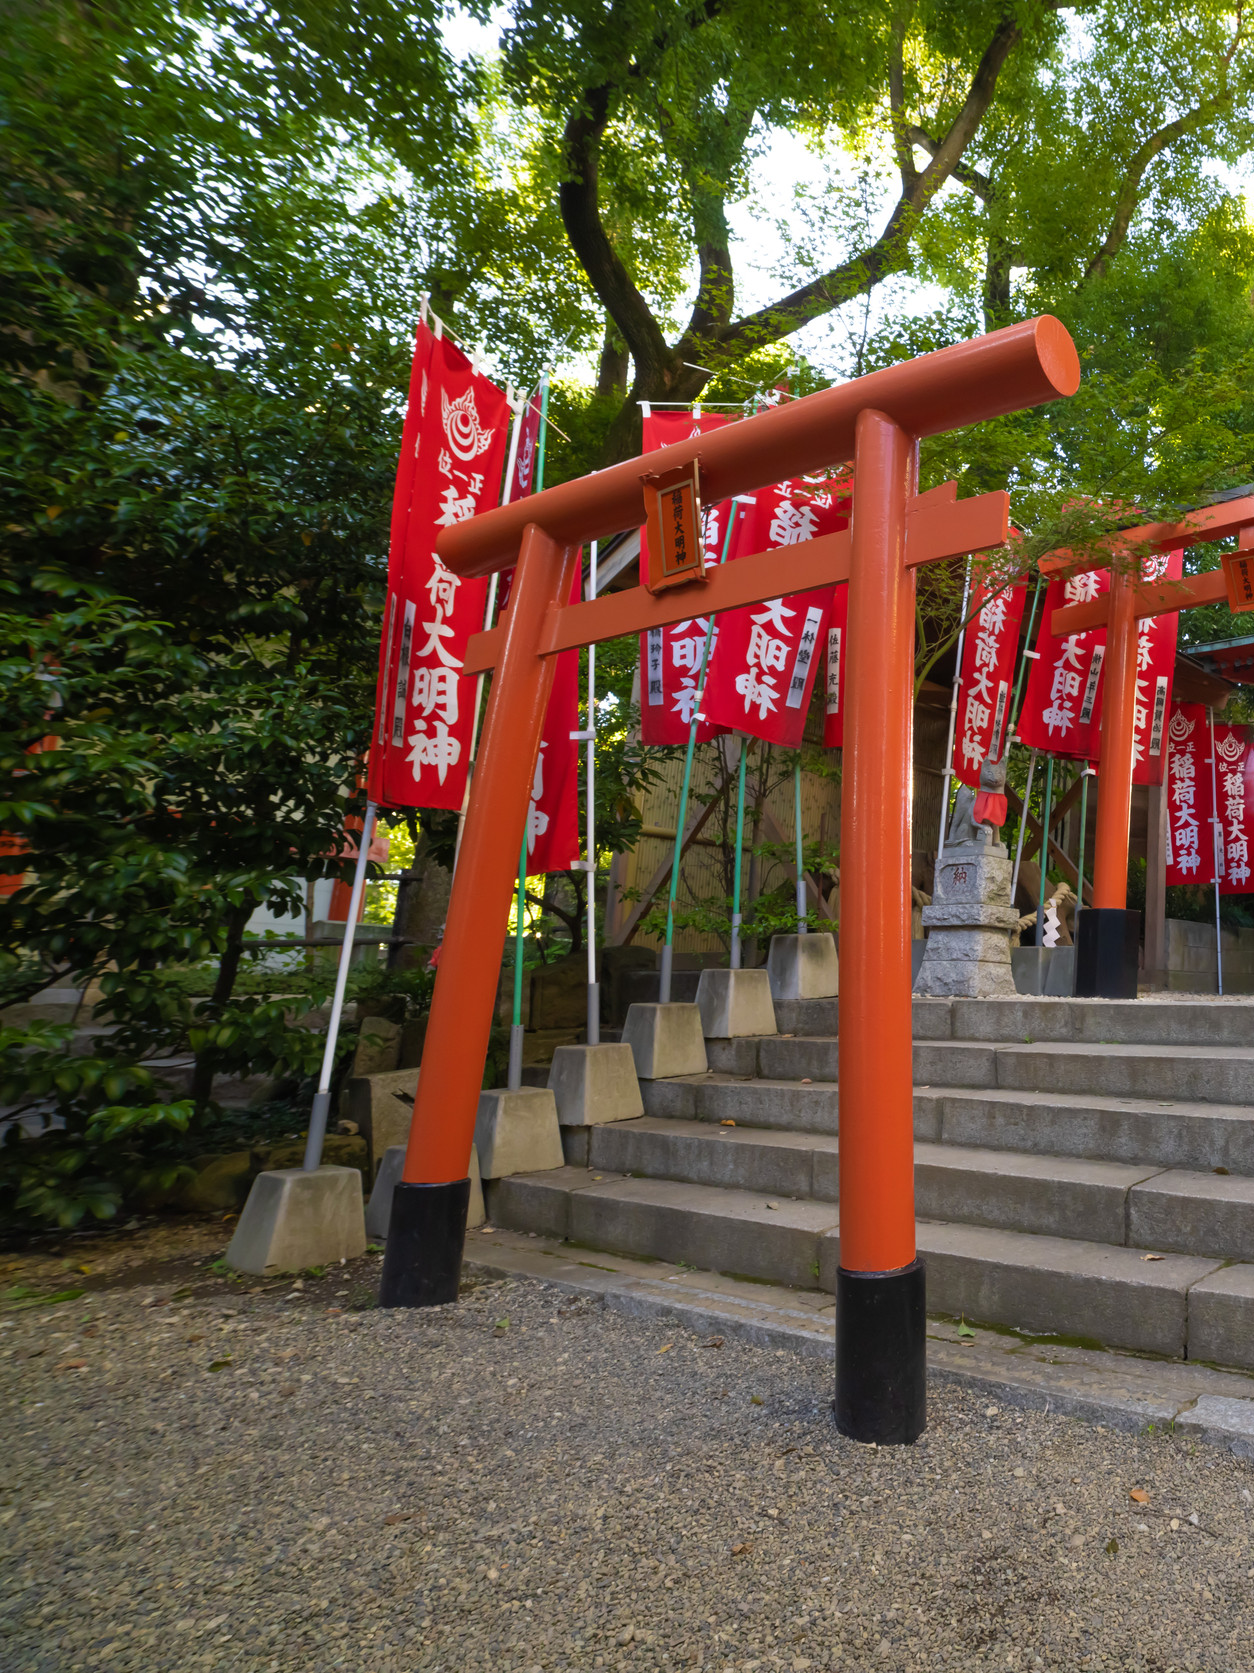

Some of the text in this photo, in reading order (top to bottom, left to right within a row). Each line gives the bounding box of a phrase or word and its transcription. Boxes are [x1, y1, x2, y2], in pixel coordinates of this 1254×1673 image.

[1169, 753, 1201, 876] 稲荷大明神
[1222, 773, 1251, 887] 稲荷大明神
